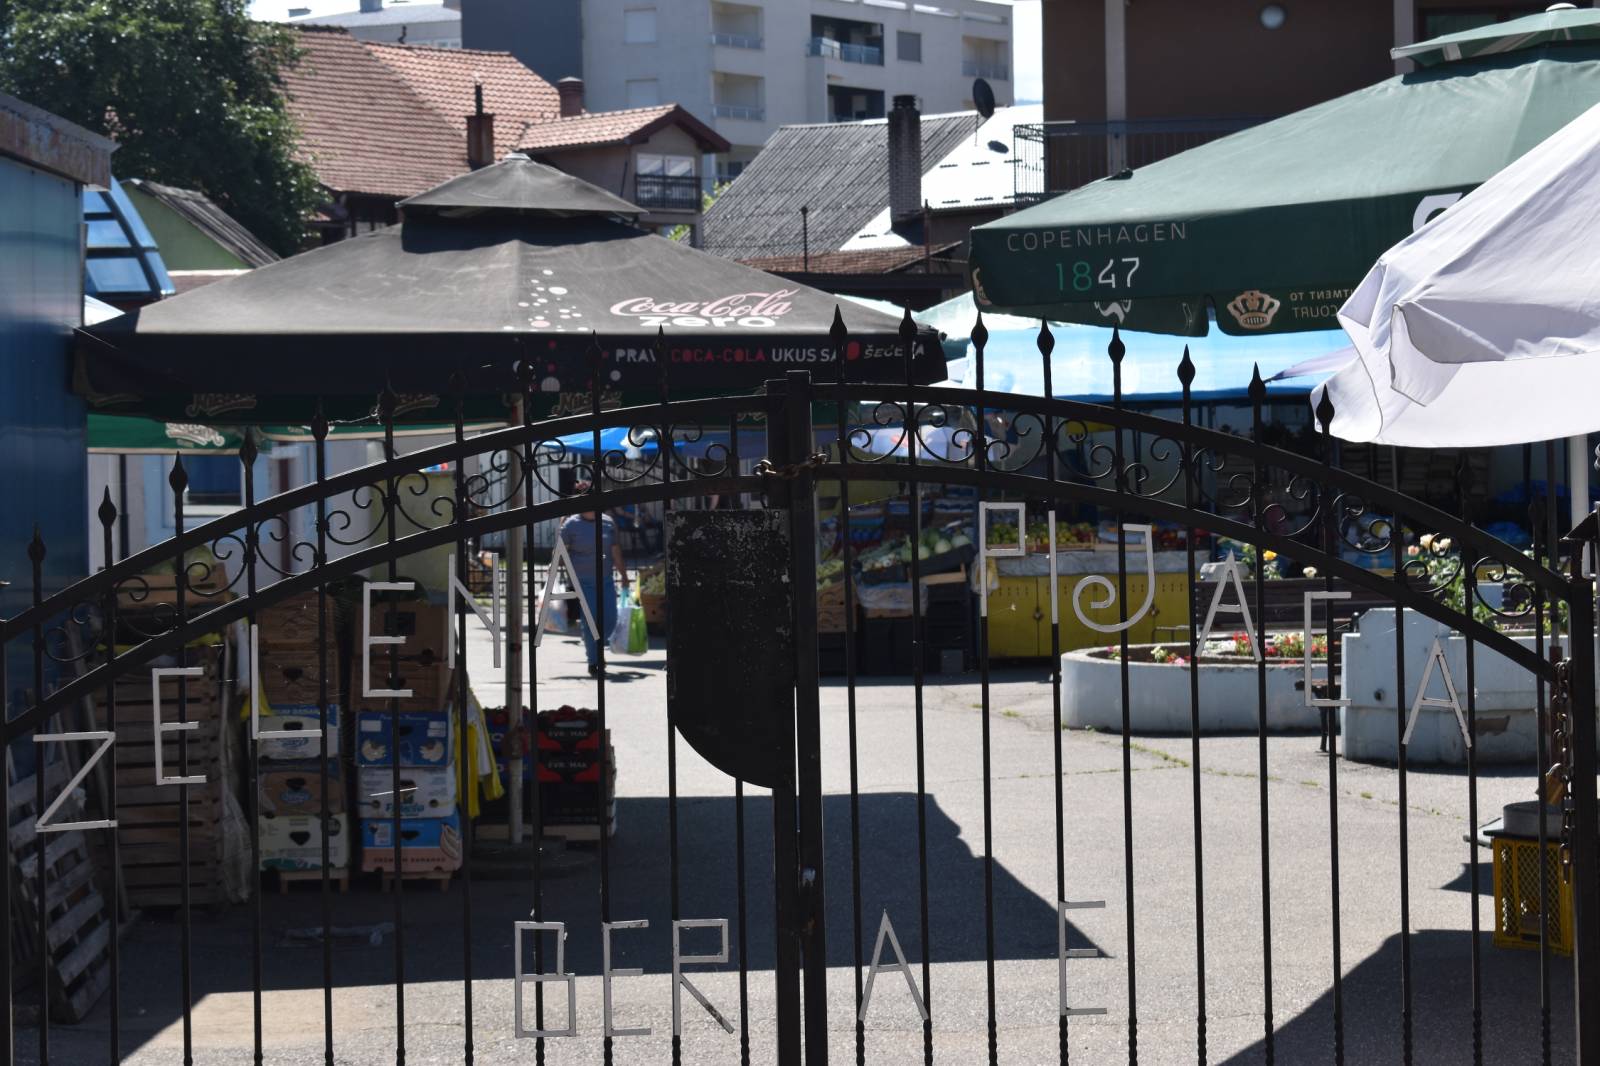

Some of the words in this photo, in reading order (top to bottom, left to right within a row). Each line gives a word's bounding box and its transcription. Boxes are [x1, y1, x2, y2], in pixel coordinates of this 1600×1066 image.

[1006, 222, 1188, 251] COPENHAGEN
[1055, 256, 1140, 291] 1847
[609, 287, 801, 317] Coca-Cola
[639, 315, 777, 328] zero
[671, 347, 766, 363] COCA-COLA
[771, 347, 818, 362] UKUS
[863, 343, 926, 361] ŠEĆEA
[33, 535, 600, 832] ZELENA
[979, 501, 1472, 748] PIJACA
